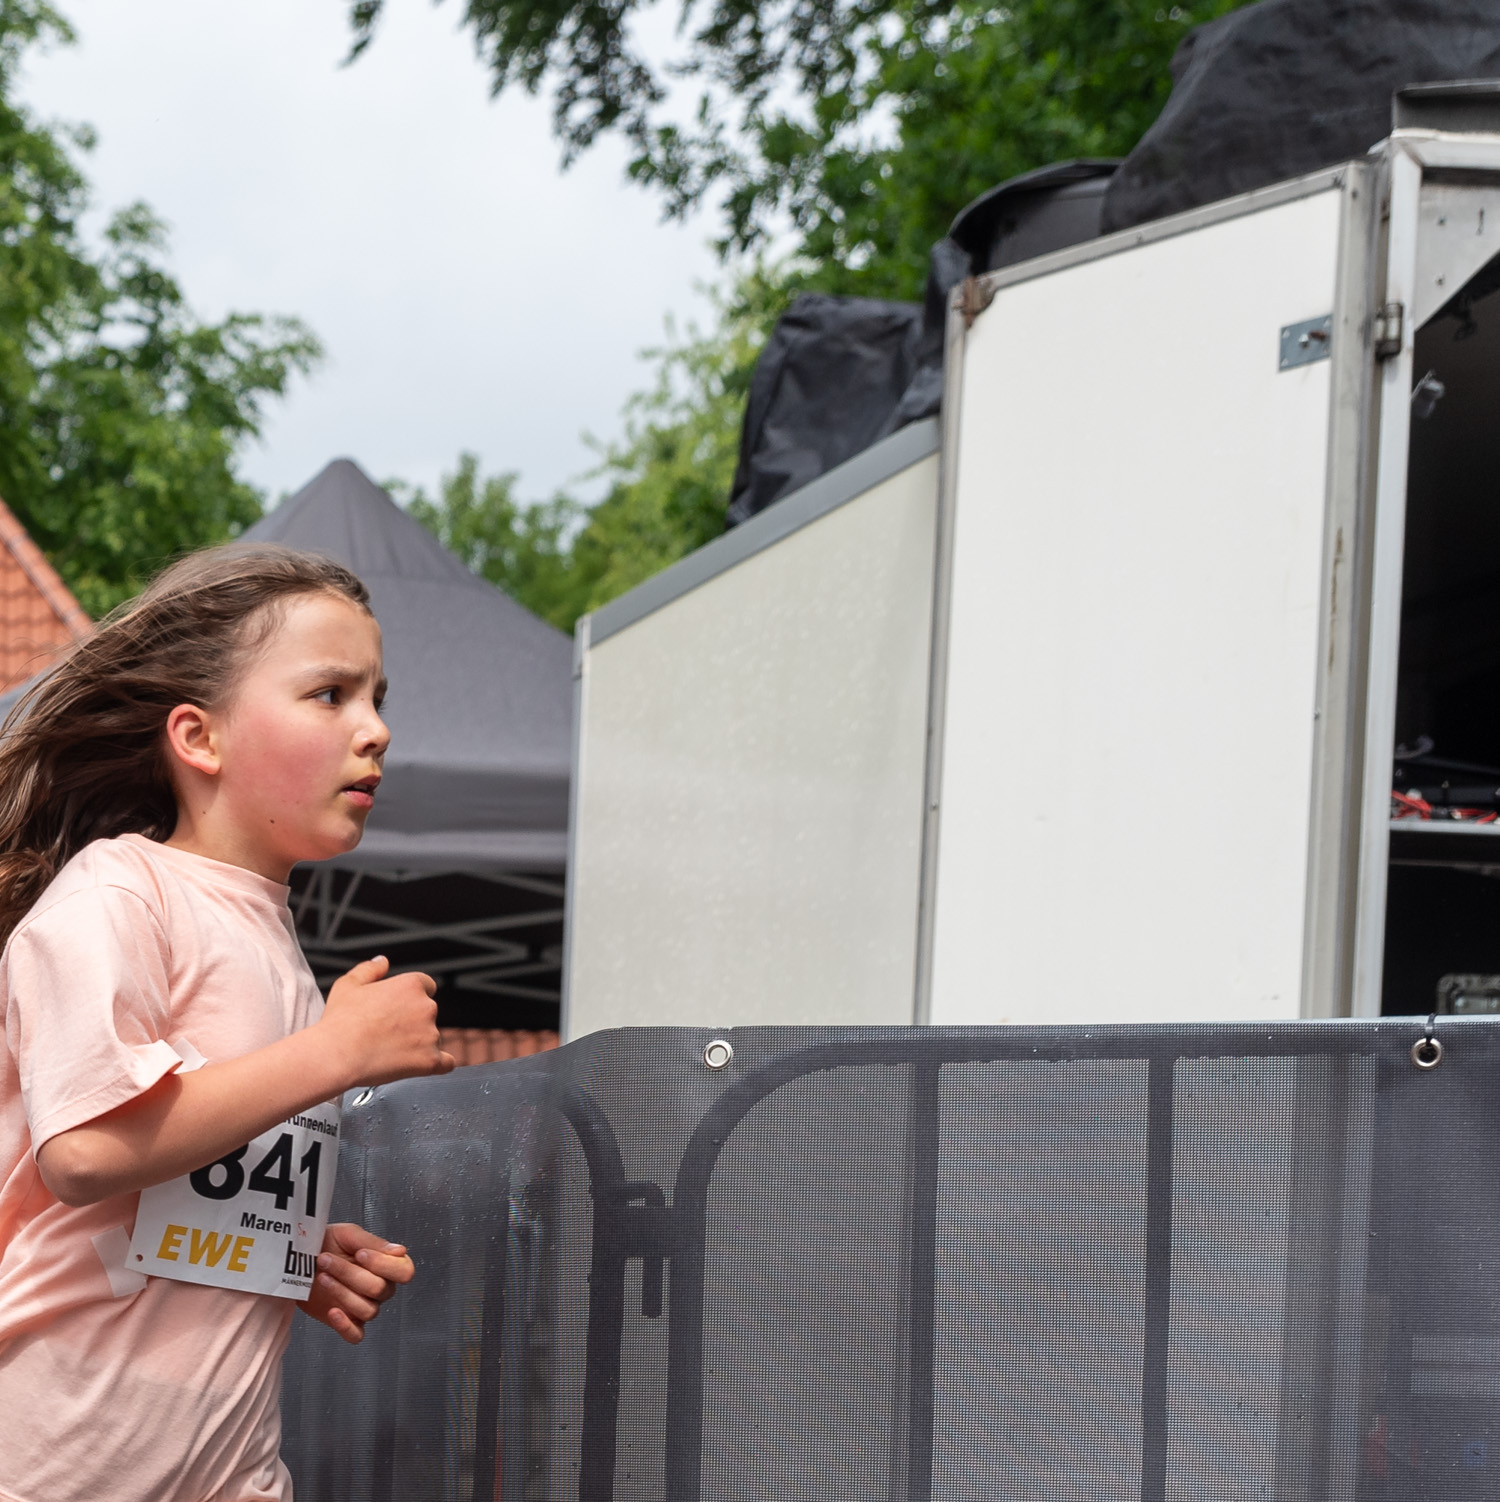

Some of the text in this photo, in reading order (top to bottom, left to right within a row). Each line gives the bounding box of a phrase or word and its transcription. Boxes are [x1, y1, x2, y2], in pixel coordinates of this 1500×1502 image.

[189, 1132, 323, 1218] 841
[240, 1211, 292, 1236] Maren
[156, 1223, 256, 1273] EWE
[284, 1240, 317, 1279] bru
